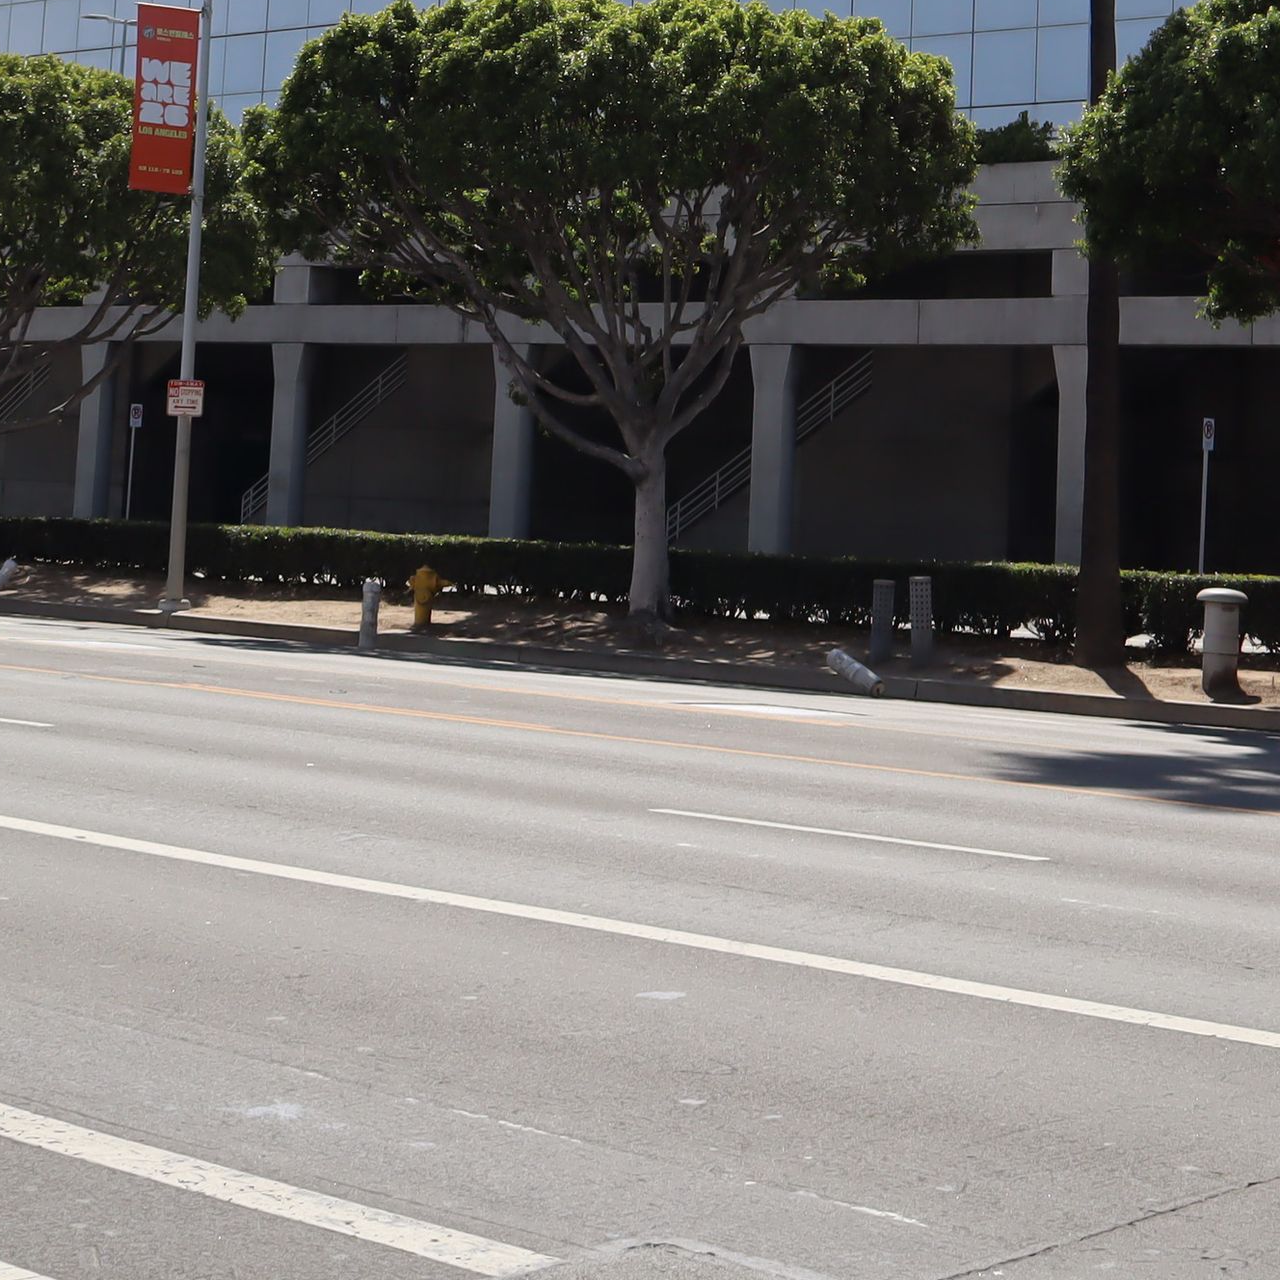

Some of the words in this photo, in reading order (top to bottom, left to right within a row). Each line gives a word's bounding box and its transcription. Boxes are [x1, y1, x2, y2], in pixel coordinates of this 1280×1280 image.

[141, 57, 192, 87] WE
[140, 82, 190, 106] ARE
[169, 387, 179, 396] NO
